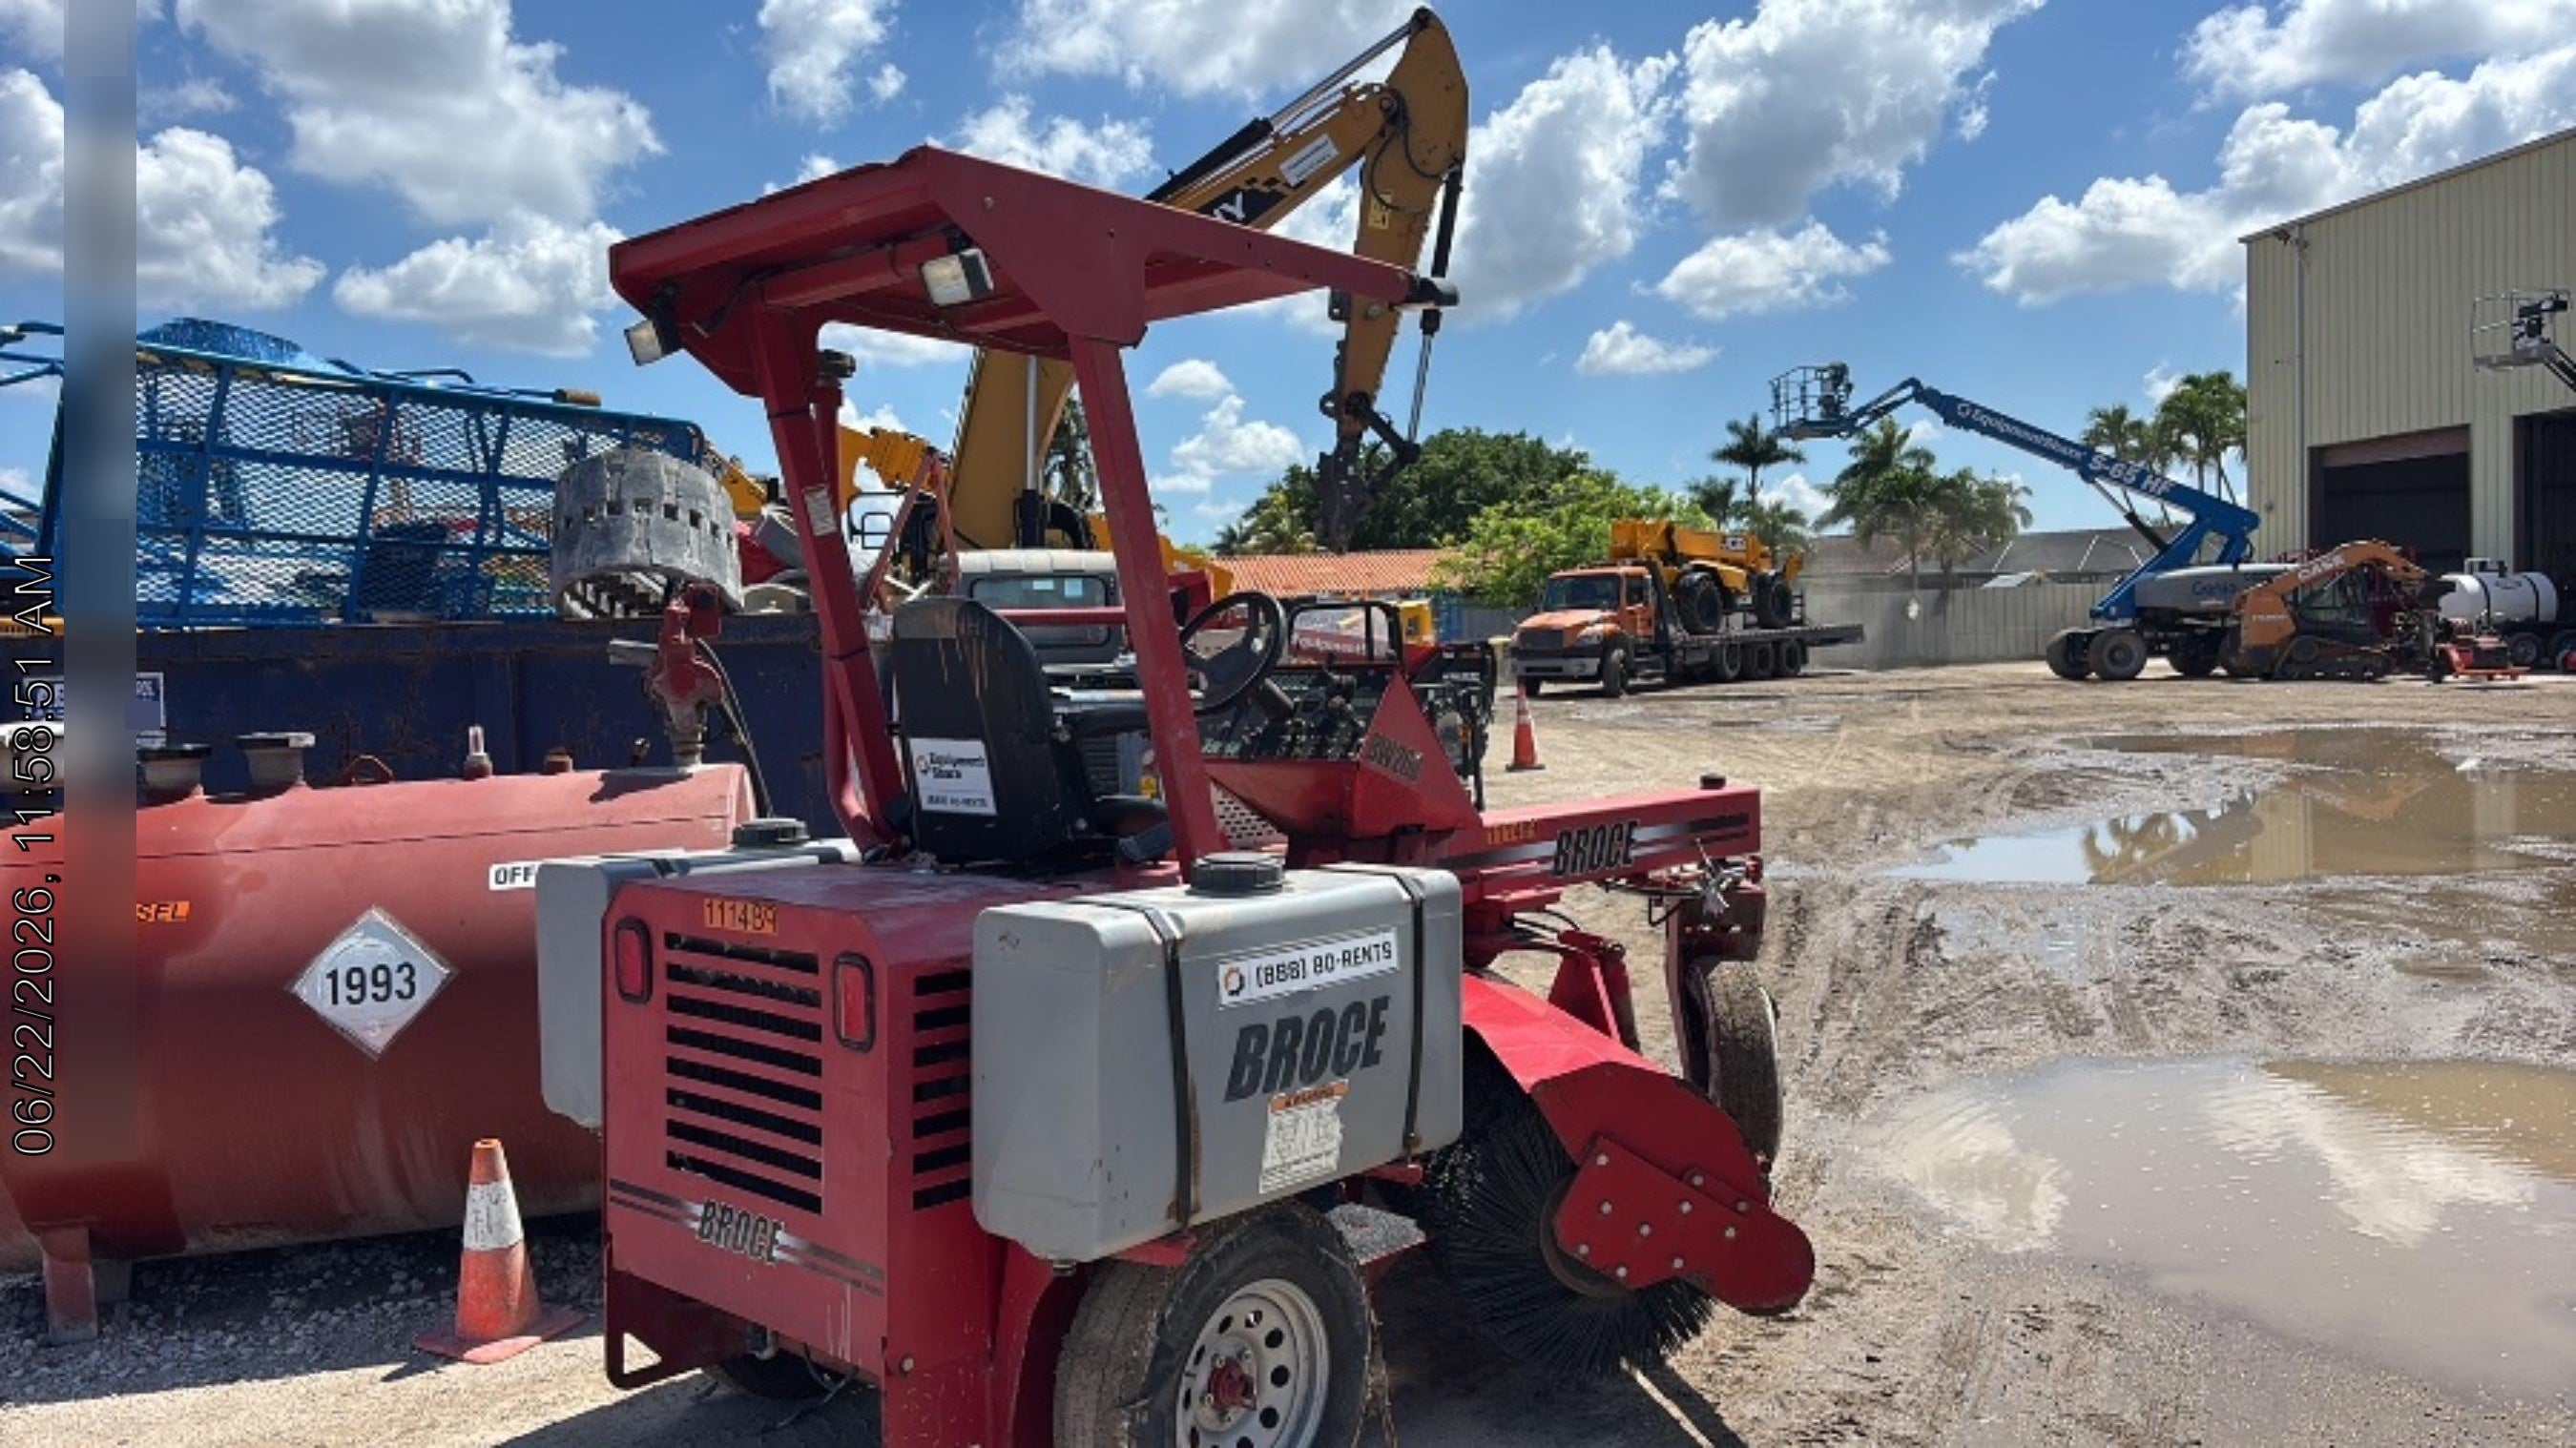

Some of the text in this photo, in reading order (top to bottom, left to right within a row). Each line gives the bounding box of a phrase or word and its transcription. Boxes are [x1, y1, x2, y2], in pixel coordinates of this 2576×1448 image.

[2089, 454, 2142, 485] S-65
[1553, 820, 1638, 876] BROCE
[325, 961, 415, 1005] 1993
[1256, 959, 1307, 988] (888)
[1225, 995, 1390, 1103] BROCE
[697, 1200, 781, 1263] BROCE
